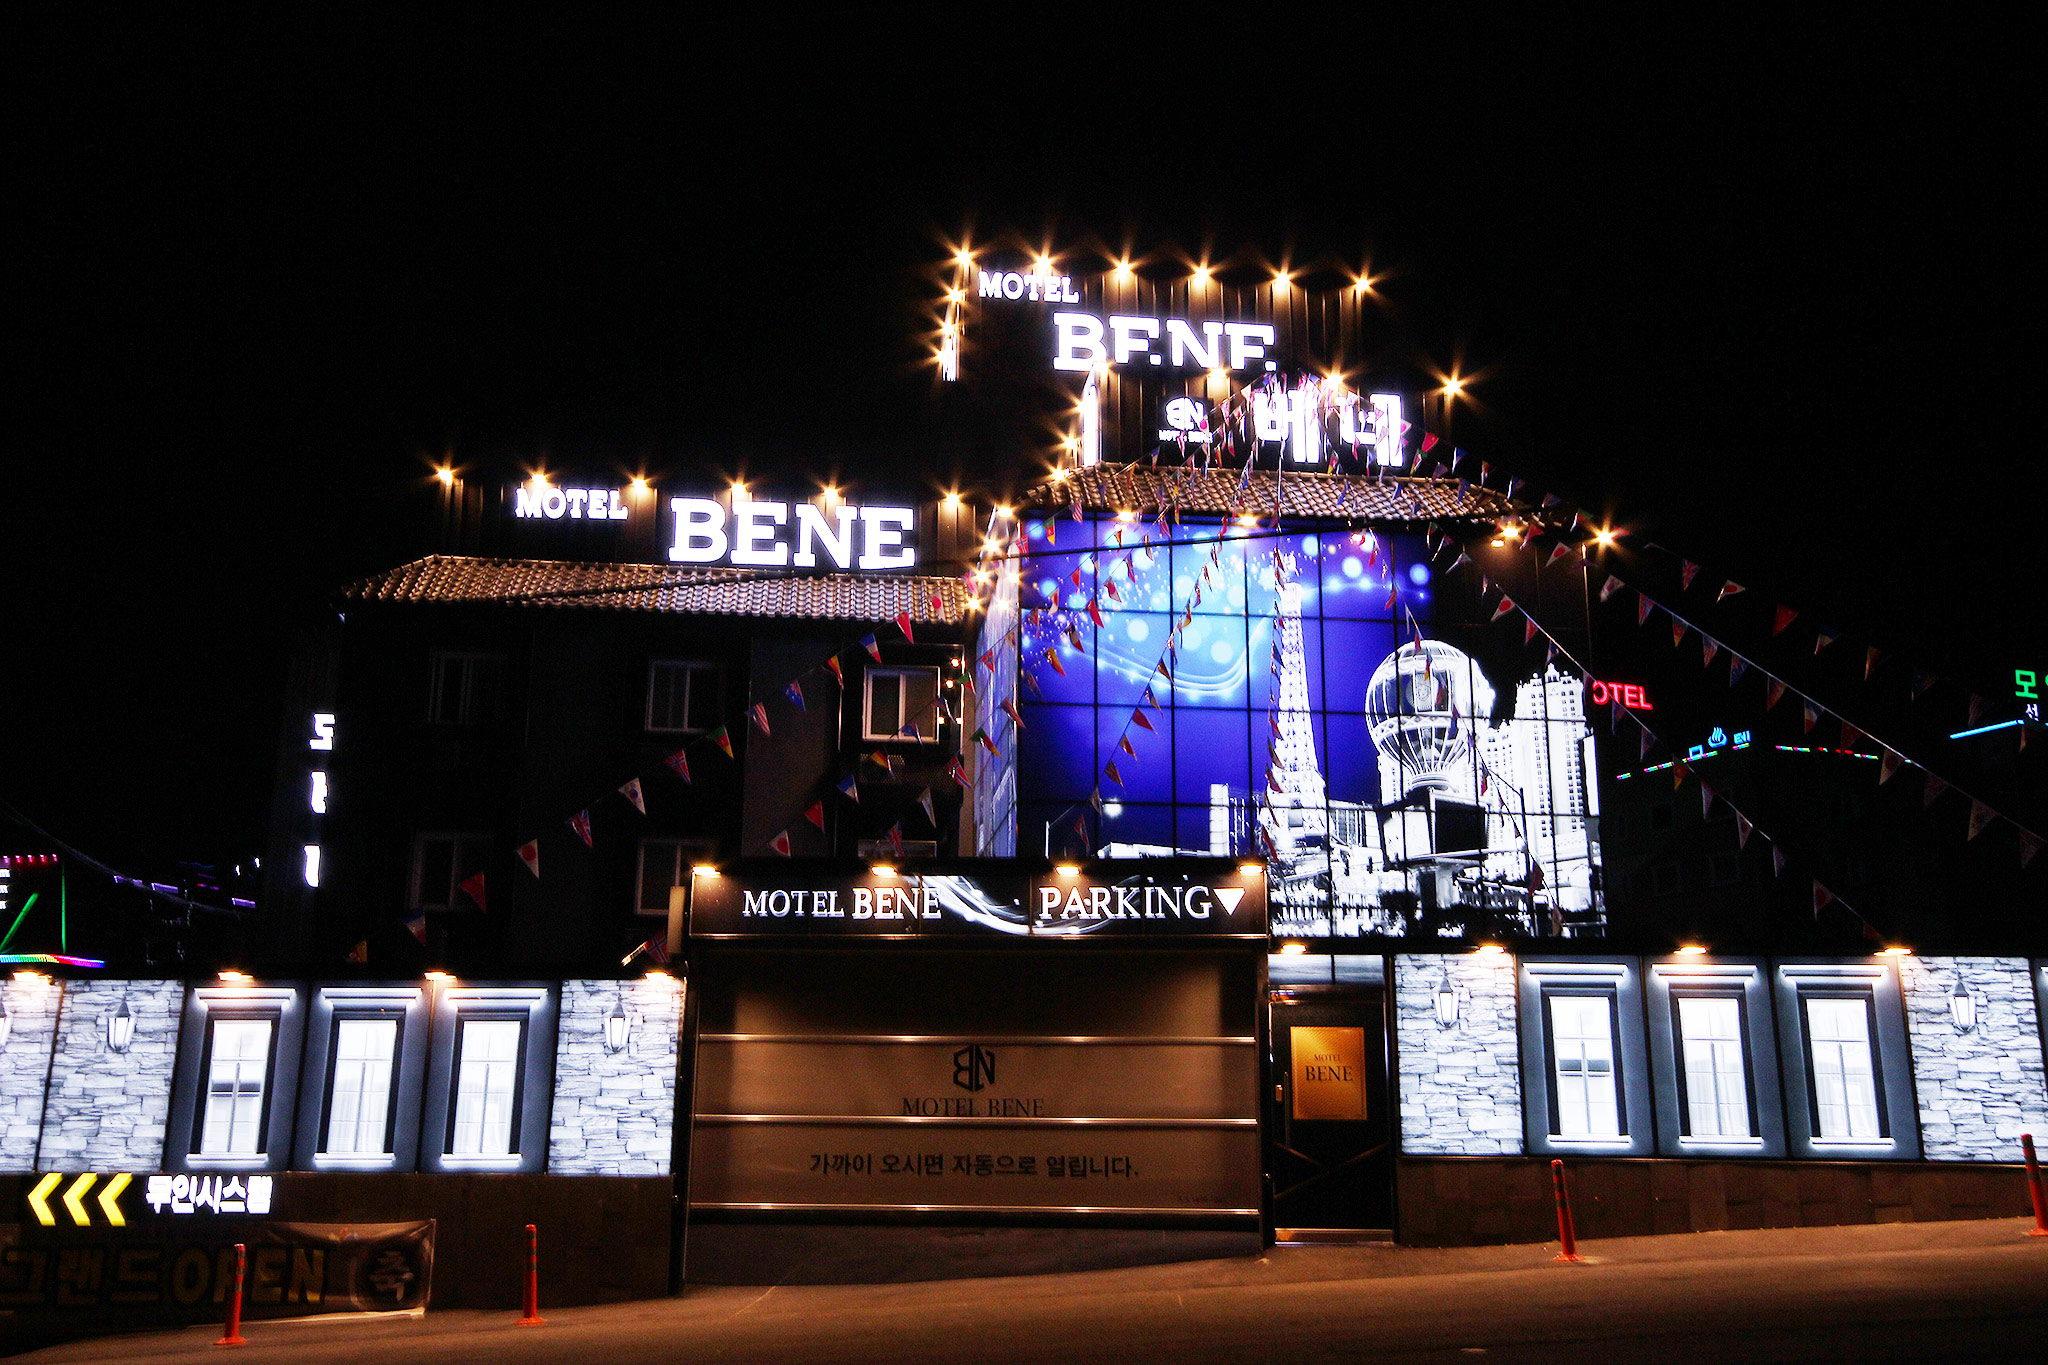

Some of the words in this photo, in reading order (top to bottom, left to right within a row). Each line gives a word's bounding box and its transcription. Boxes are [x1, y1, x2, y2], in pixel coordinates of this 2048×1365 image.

[978, 271, 1080, 304] MOTEL
[514, 488, 629, 520] MOTEL
[668, 496, 916, 570] BENE
[1592, 680, 1654, 711] OTEL
[2014, 669, 2048, 699] 모
[742, 888, 844, 918] MOTEL
[852, 886, 942, 920] BENE
[1038, 886, 1212, 920] PARKING
[1313, 1053, 1342, 1062] MOTEL
[1305, 1065, 1353, 1082] BENE
[902, 1098, 979, 1117] MOTEL
[988, 1098, 1045, 1118] BENE
[810, 1153, 872, 1176] 가까이
[880, 1153, 944, 1177] 오시면
[952, 1153, 1037, 1178] 자동으로
[1046, 1154, 1139, 1178] 열립니다.
